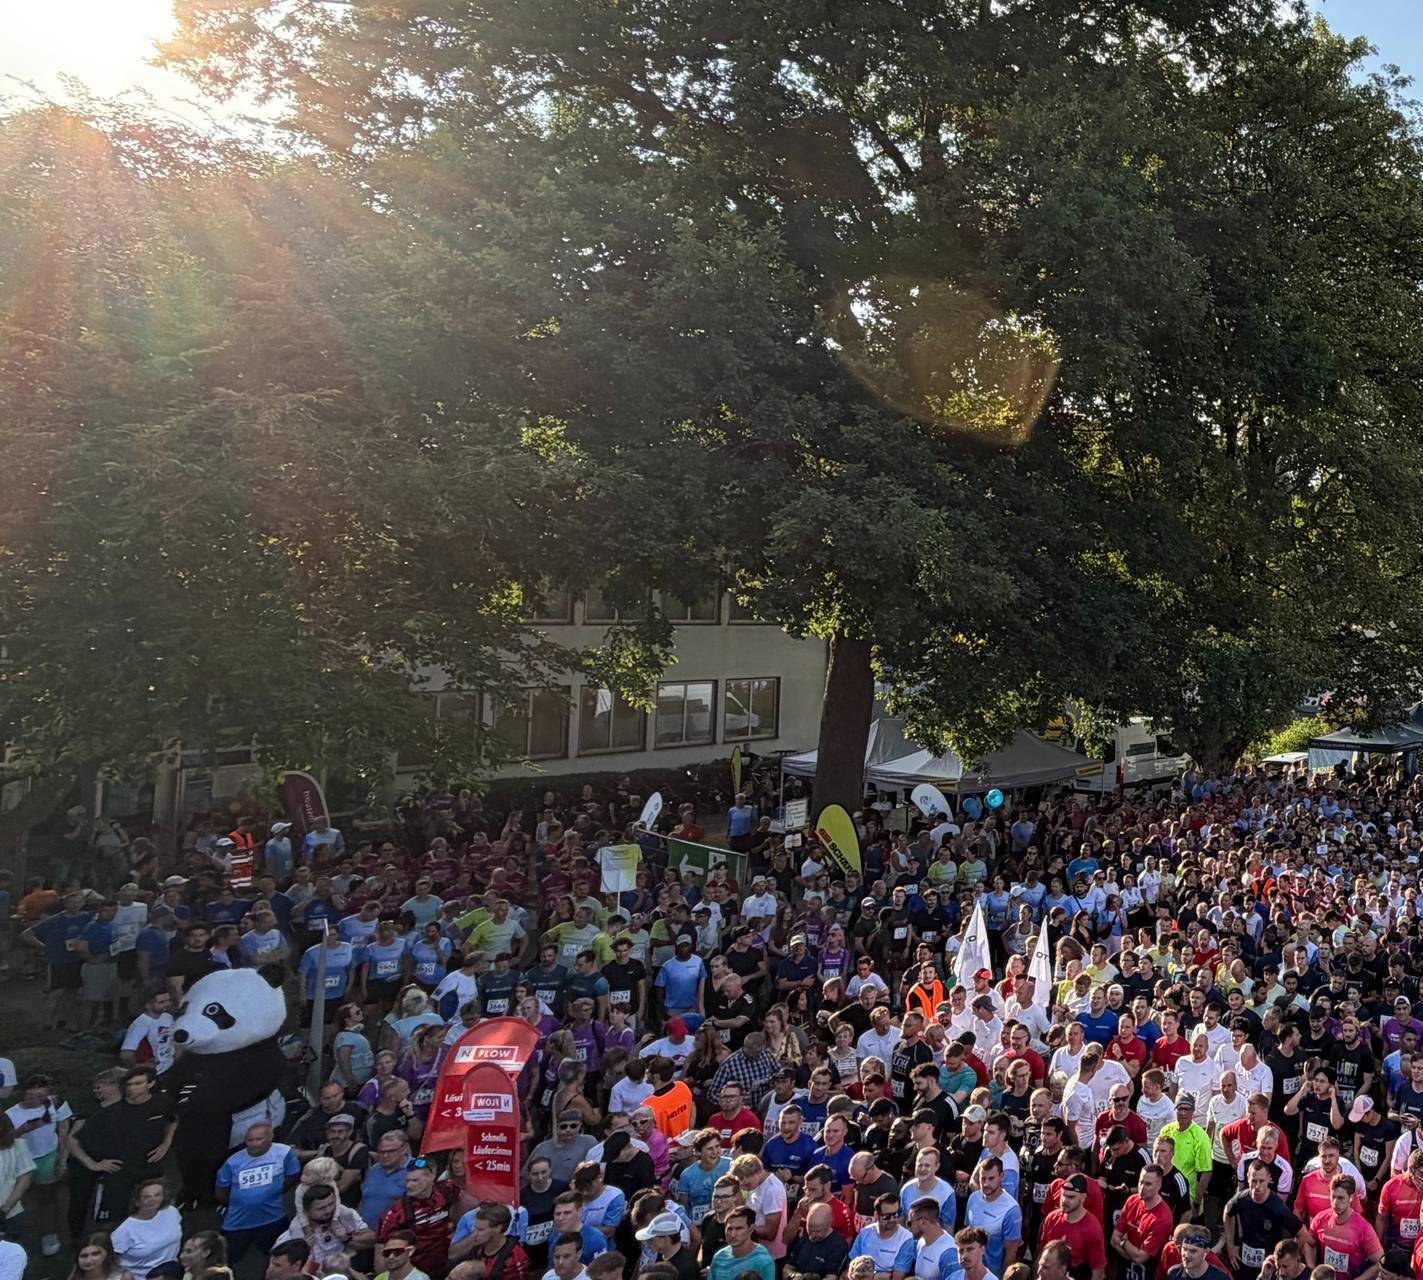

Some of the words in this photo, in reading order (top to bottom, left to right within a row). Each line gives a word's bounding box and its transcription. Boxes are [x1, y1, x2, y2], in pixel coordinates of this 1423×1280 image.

[462, 1050, 472, 1059] N
[478, 1049, 512, 1059] FLOW
[667, 1105, 688, 1121] HELFER
[480, 1133, 508, 1143] Schnelle
[486, 1160, 512, 1173] 25min
[241, 1173, 270, 1186] 5831
